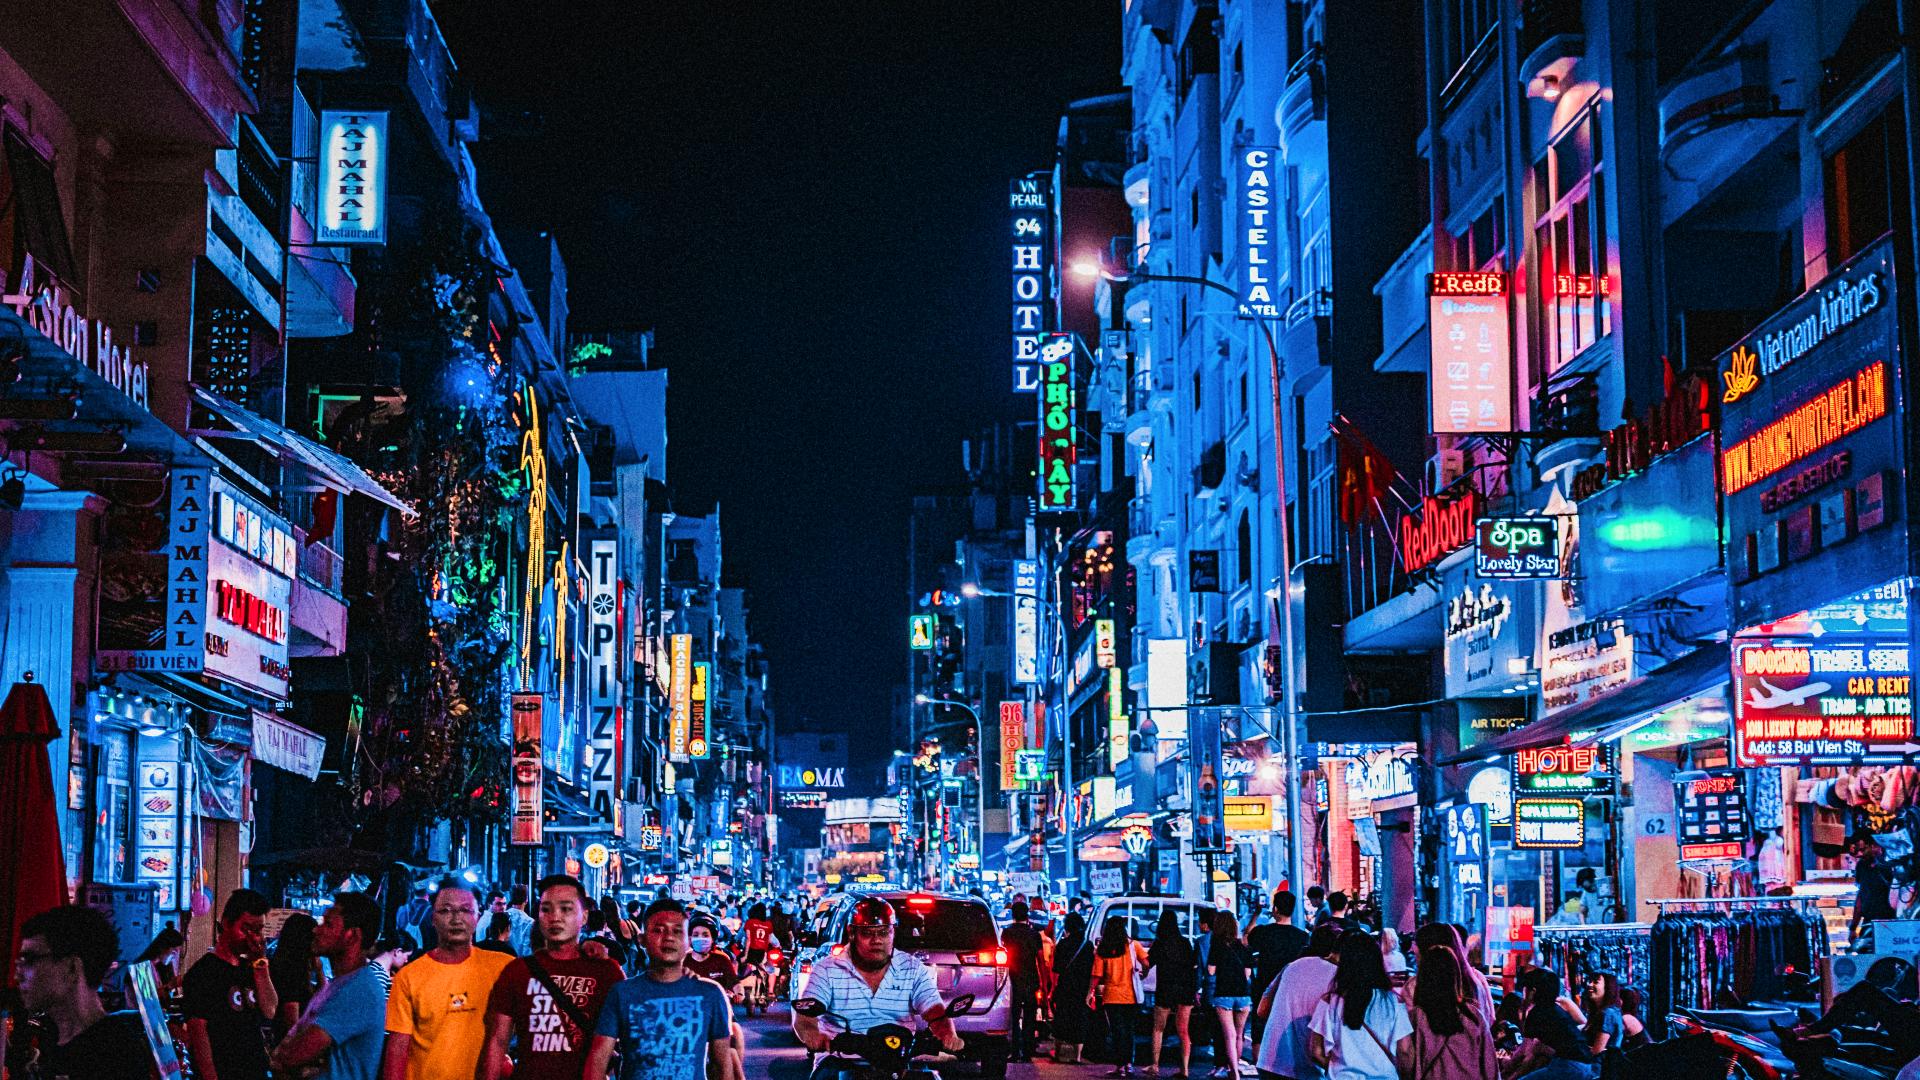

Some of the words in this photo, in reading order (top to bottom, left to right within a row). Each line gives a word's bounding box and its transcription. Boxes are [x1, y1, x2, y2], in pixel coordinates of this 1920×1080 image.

[341, 115, 368, 151] TAJ
[338, 159, 366, 221] MAHAL
[1019, 179, 1037, 192] VN
[1011, 194, 1044, 206] PEARL
[321, 226, 378, 239] Restaurant
[1015, 217, 1041, 236] 94
[1246, 150, 1271, 302] CASTELLA
[1014, 245, 1041, 390] HOTEL
[1757, 314, 1818, 376] Vietnam
[1818, 272, 1879, 340] Airlines
[97, 319, 149, 413] Hotel
[176, 474, 201, 533] TAJ
[1401, 489, 1476, 575] RedDoorz
[1490, 521, 1544, 554] Spa
[1481, 555, 1523, 573] Lovely
[1527, 555, 1555, 570] Star
[175, 545, 202, 647] MAHAL
[1745, 649, 1811, 675] BOOKING
[1848, 676, 1875, 695] CAR
[1877, 676, 1911, 695] RENT
[1001, 703, 1023, 723] 96
[1471, 718, 1488, 729] AIR
[1490, 717, 1526, 728] TICK
[1764, 719, 1796, 738] LUXURY
[1871, 719, 1903, 738] PRIVATE
[1003, 724, 1020, 787] HOTEL
[1748, 740, 1776, 754] Add:
[1778, 740, 1793, 754] 58
[1795, 740, 1814, 754] Bui
[1815, 740, 1843, 754] Vien
[1517, 749, 1607, 773] HOTEL
[1645, 818, 1666, 834] 62
[530, 993, 589, 1014] STP
